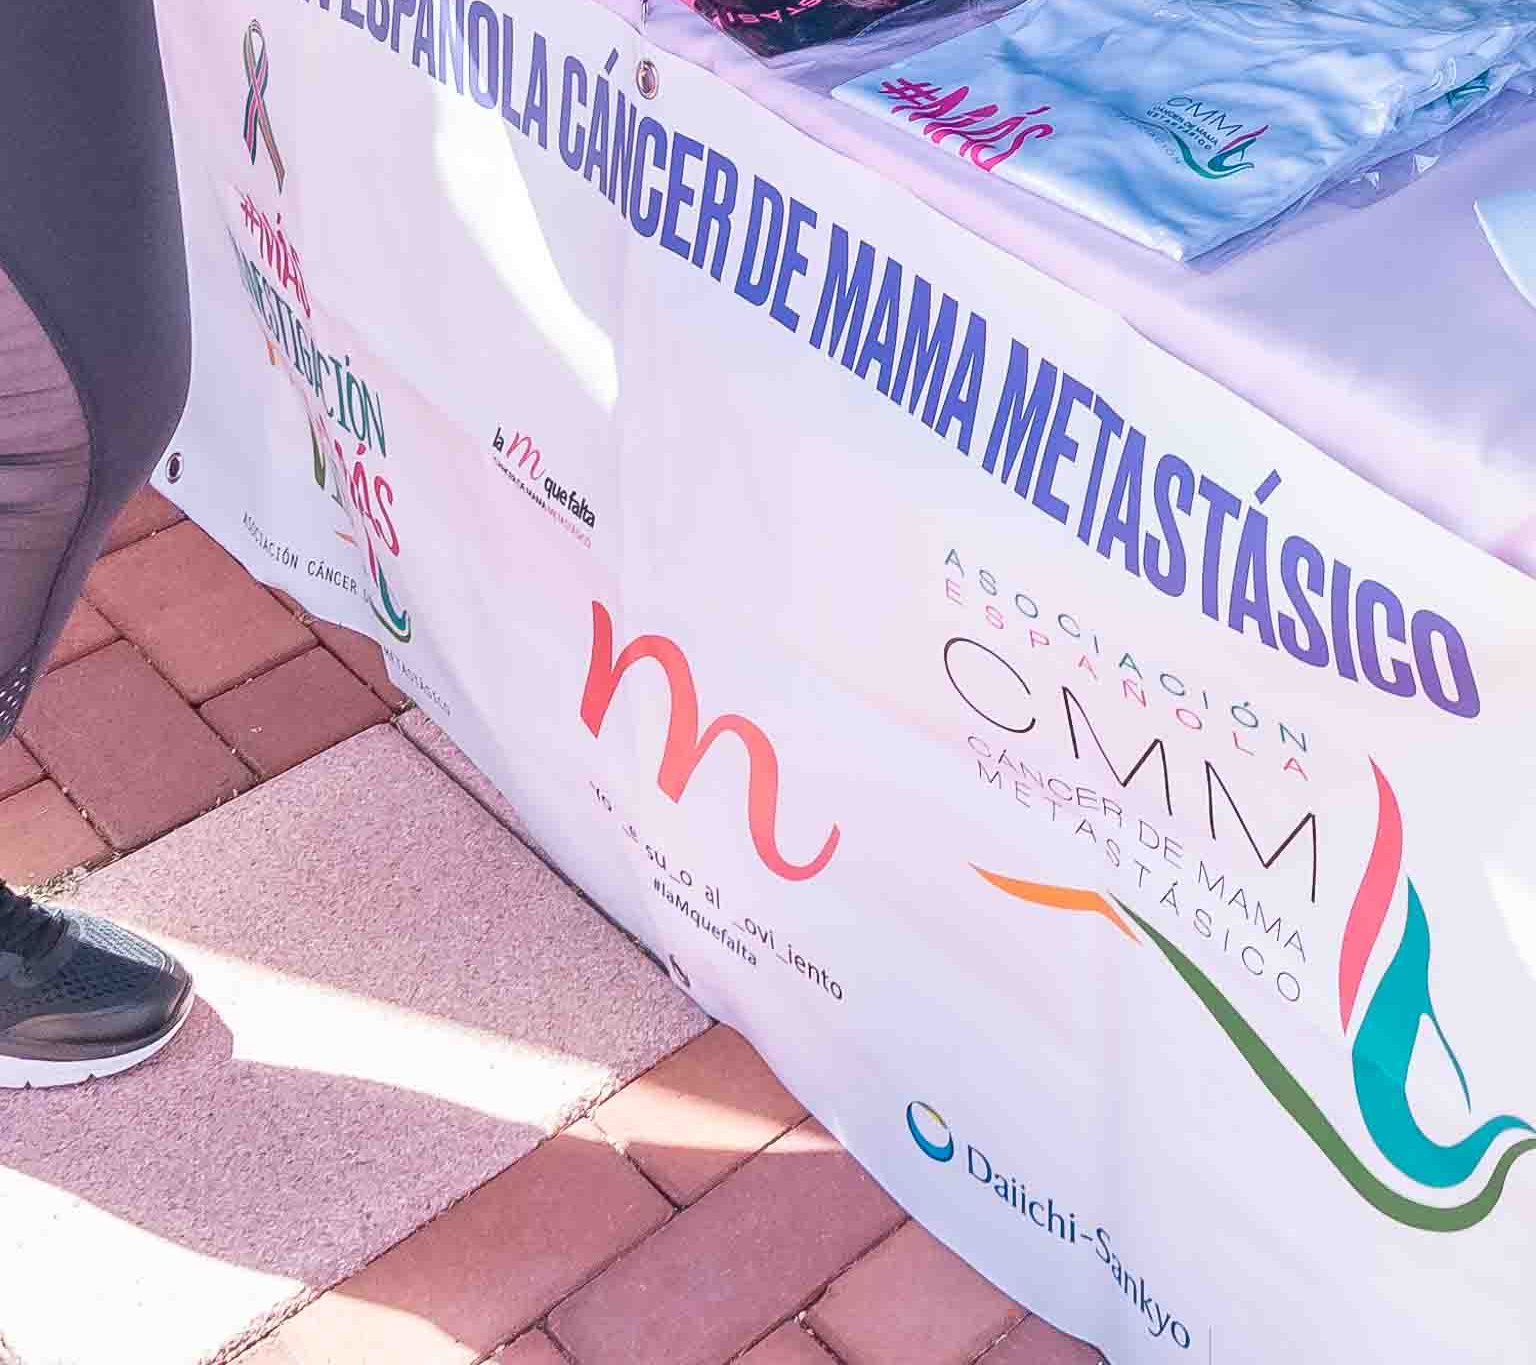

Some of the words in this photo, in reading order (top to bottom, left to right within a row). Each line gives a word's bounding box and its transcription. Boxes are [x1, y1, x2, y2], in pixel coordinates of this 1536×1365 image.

[877, 75, 1056, 172] #MÁS
[1166, 96, 1244, 137] CMM
[492, 426, 505, 453] la
[543, 475, 568, 506] que
[567, 489, 596, 529] falta
[557, 48, 739, 284] CÁNCER
[734, 175, 818, 334] DE
[808, 221, 990, 457] MAMA
[980, 336, 1484, 721] METASTÁSICO
[307, 559, 358, 596] CÁNCER
[943, 545, 1310, 754] ASOCIACIÓN
[945, 577, 1312, 783] ESPAÑOLA
[943, 635, 1320, 904] CMM
[965, 733, 1125, 832] CÁNCER
[1137, 817, 1186, 870] DE
[1196, 860, 1307, 963] MAMA
[652, 877, 758, 967] #laMquefalta
[704, 883, 722, 911] al
[975, 759, 1303, 1006] METASTÁSICO
[965, 1143, 1193, 1351] Daiichi-Sankyo
